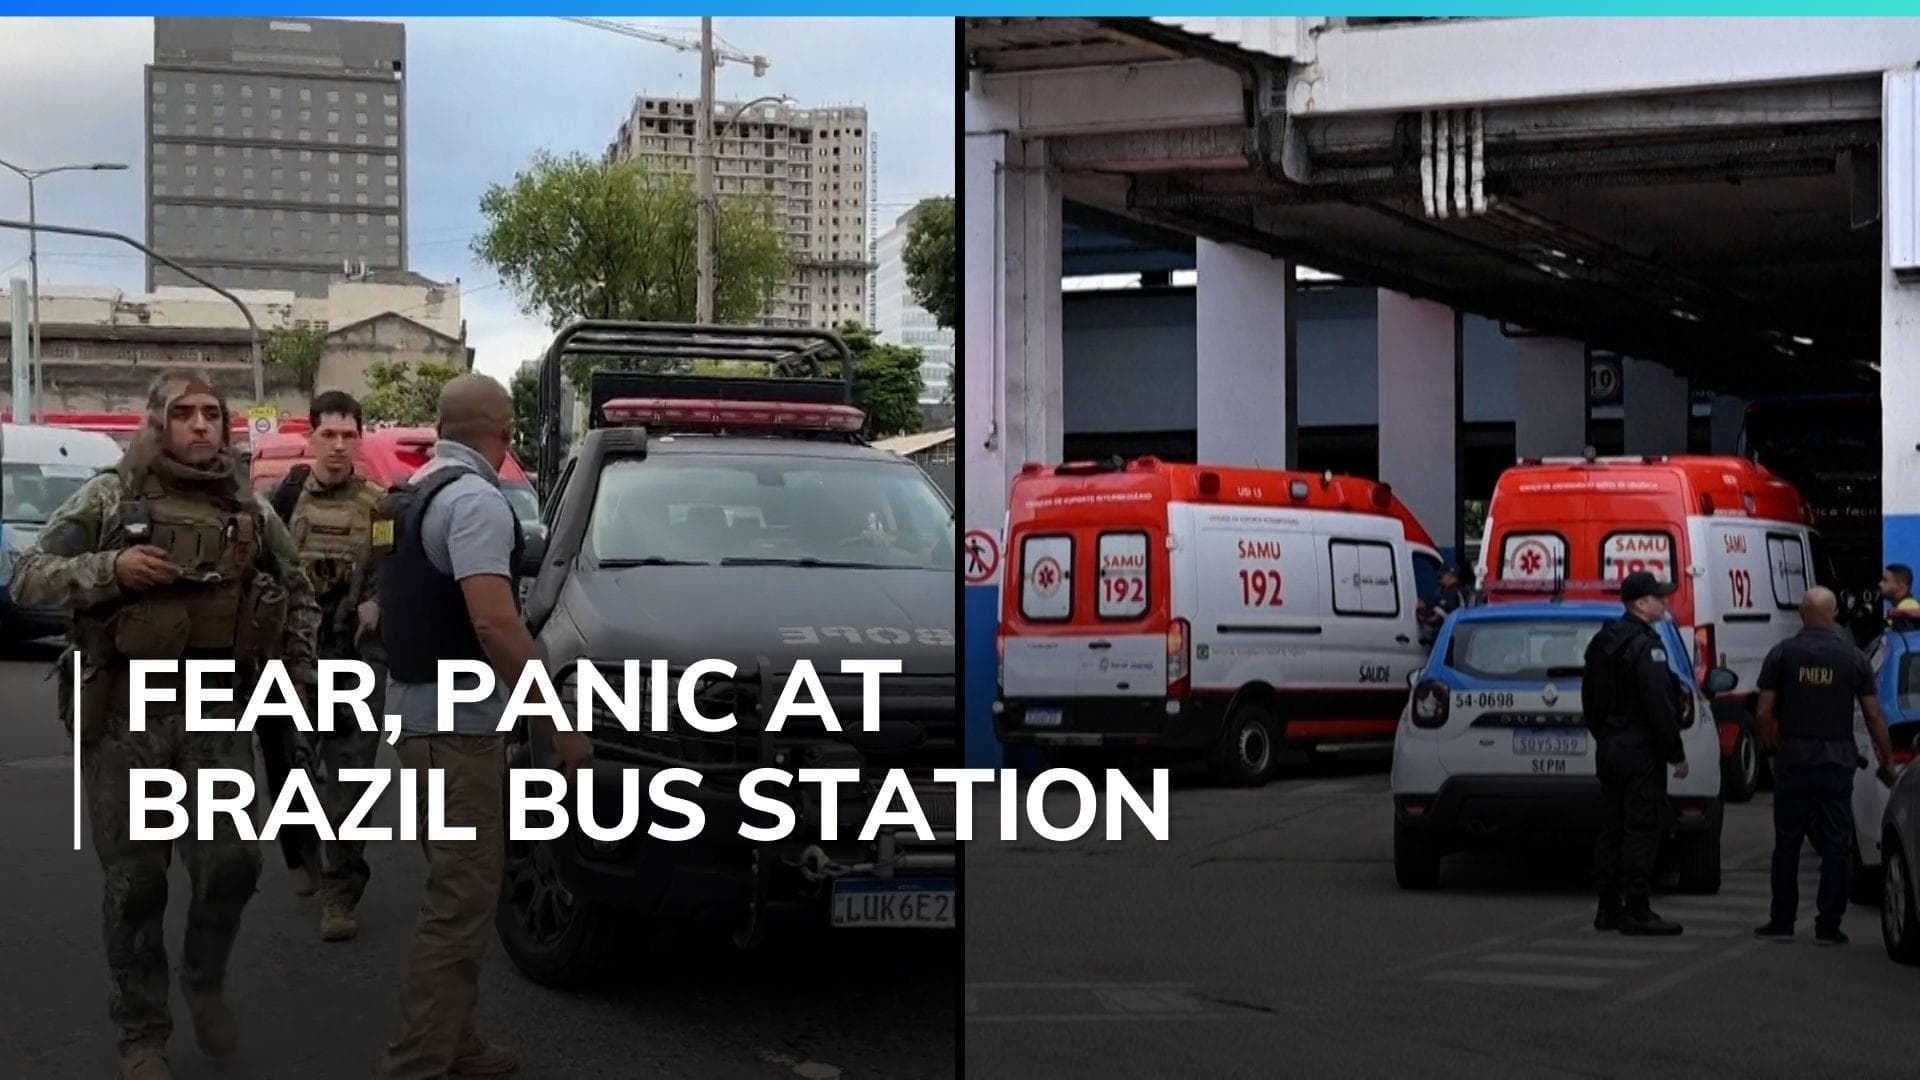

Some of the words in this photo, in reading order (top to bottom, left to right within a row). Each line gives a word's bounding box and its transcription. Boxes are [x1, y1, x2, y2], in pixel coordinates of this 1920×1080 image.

[1238, 540, 1280, 559] SAMU
[1616, 538, 1667, 551] SAMU
[1724, 534, 1746, 553] SAMU
[1103, 555, 1144, 567] SAMU
[1103, 577, 1144, 602] 192
[1239, 569, 1283, 606] 192
[1729, 569, 1753, 608] 192
[1456, 693, 1514, 708] 54-0698
[1531, 759, 1566, 773] SEPM
